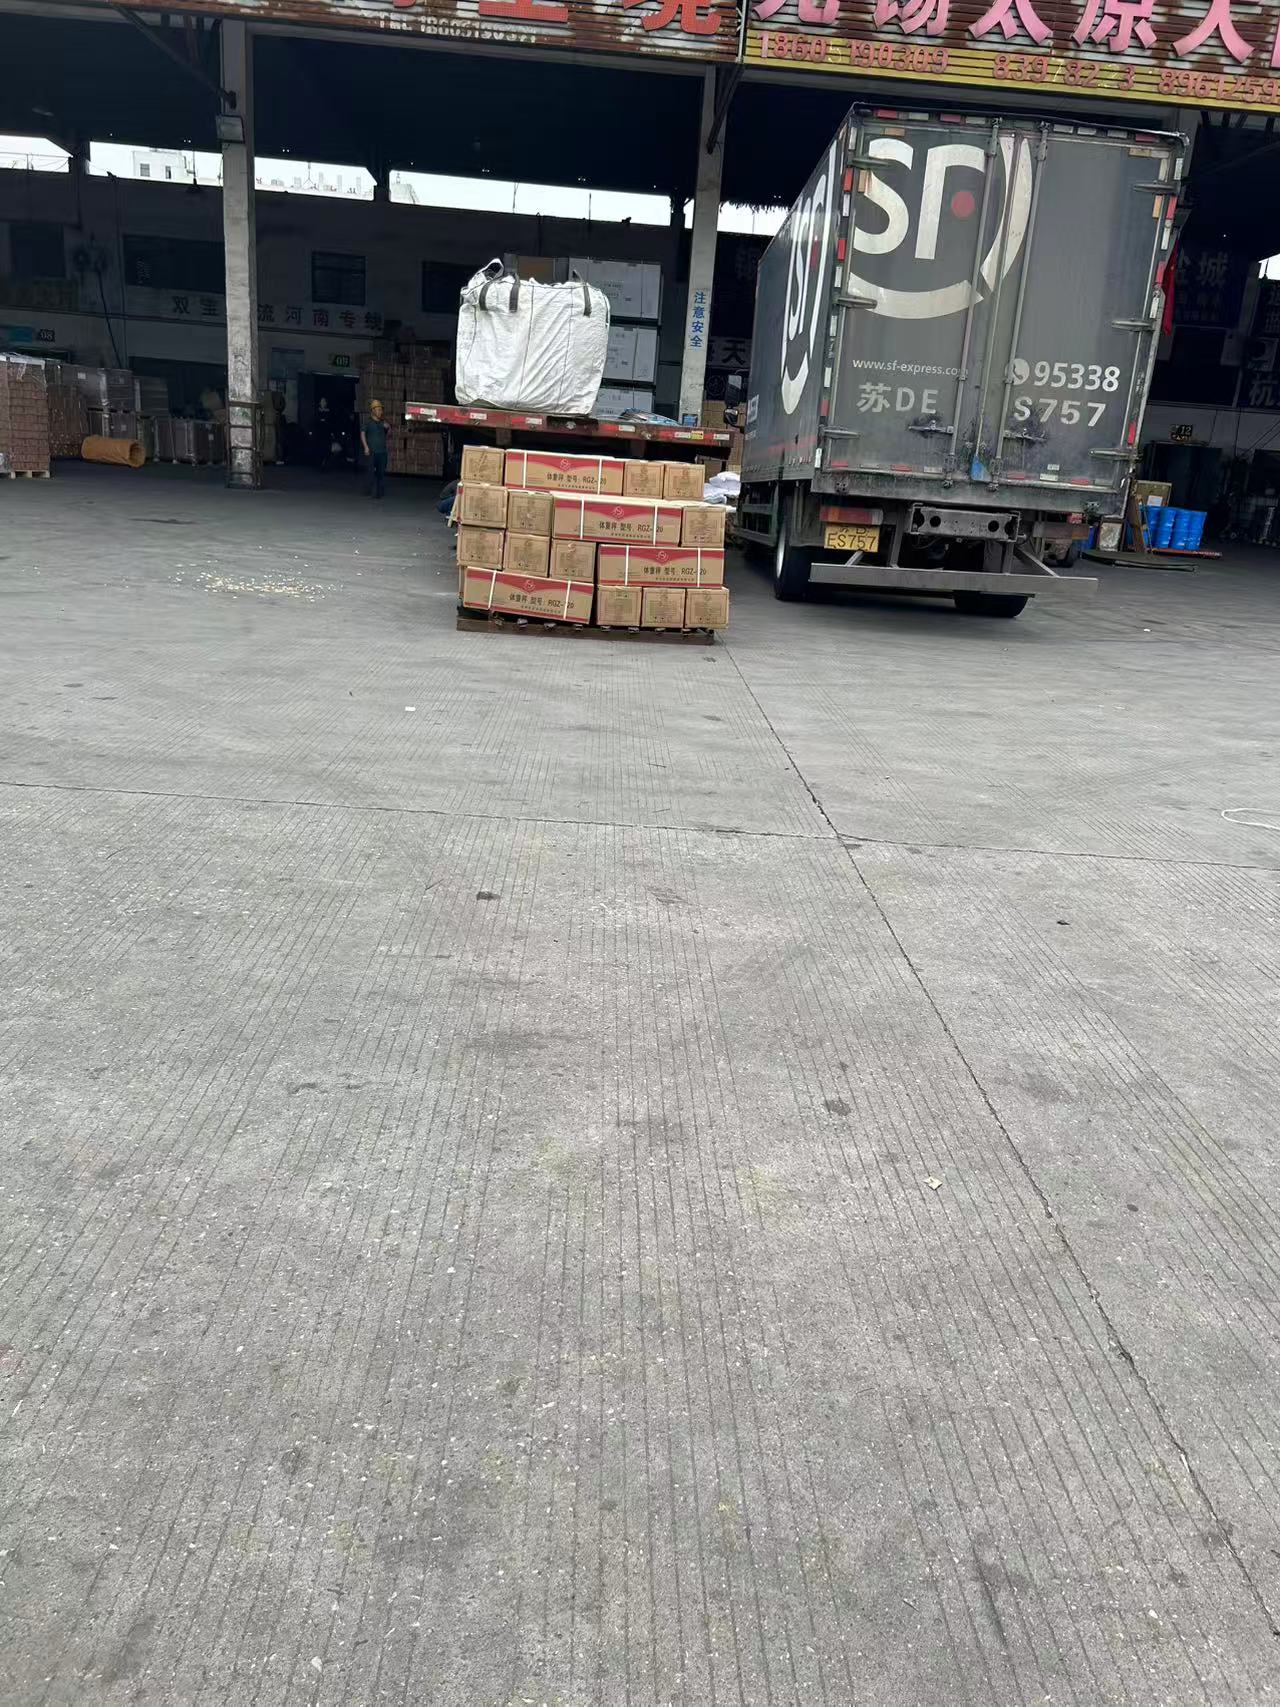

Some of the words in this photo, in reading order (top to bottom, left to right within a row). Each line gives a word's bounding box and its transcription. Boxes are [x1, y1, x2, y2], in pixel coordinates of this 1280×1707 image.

[690, 291, 707, 348] 注意安全
[1032, 360, 1120, 392] 95338
[856, 381, 939, 414] 苏DE
[1013, 396, 1106, 427] S757
[583, 475, 607, 485] RGZ-20
[637, 523, 664, 533] RGZ-20
[827, 531, 877, 551] ES757
[681, 567, 707, 576] RGZ-20
[547, 598, 575, 609] RGZ-20
